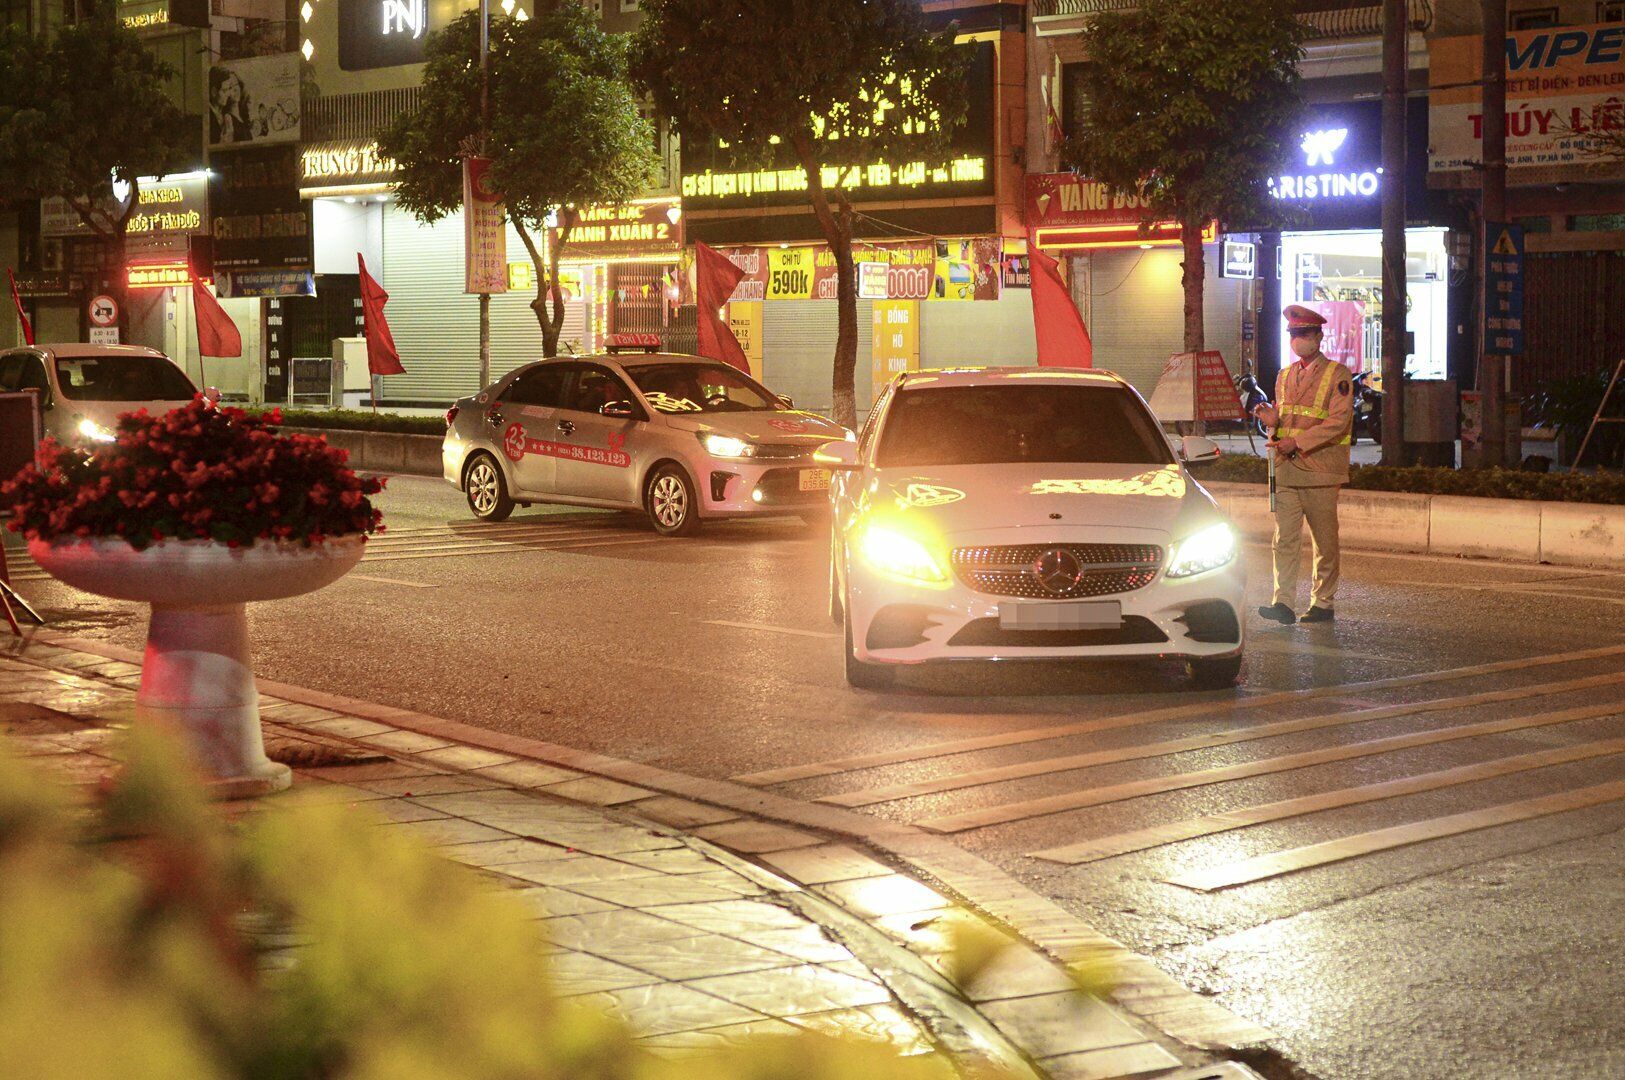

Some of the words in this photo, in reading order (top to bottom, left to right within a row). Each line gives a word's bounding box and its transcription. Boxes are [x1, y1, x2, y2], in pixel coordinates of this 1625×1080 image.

[382, 0, 422, 39] PNJ
[1467, 103, 1553, 139] TÚY
[126, 212, 149, 233] UỐC
[609, 221, 654, 241] XUÂN
[656, 223, 669, 239] 2
[772, 270, 809, 295] 590k
[637, 333, 659, 345] 123
